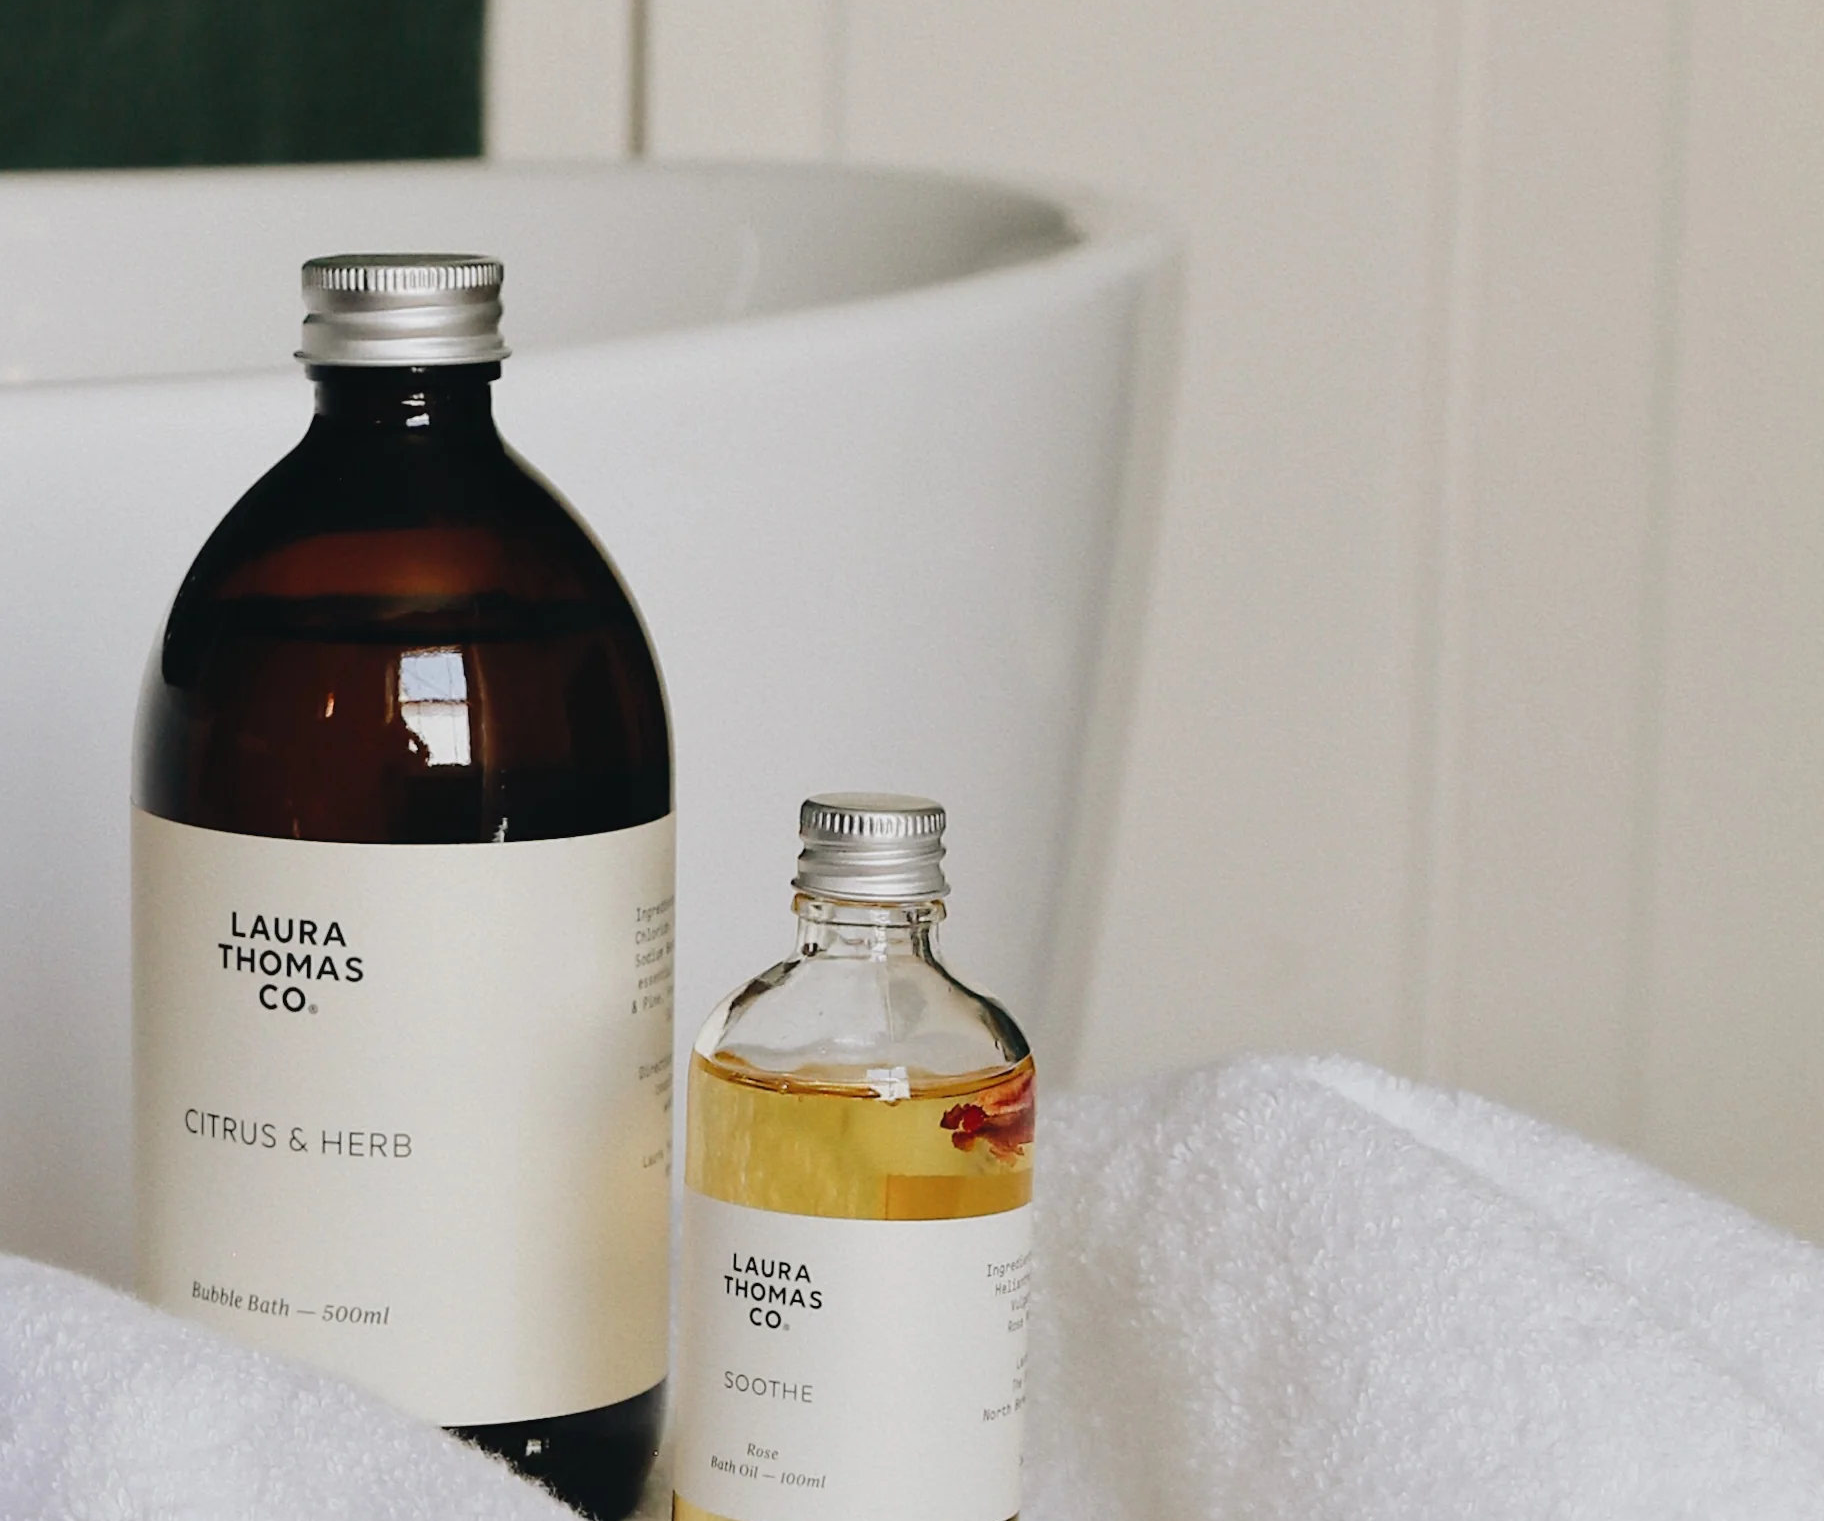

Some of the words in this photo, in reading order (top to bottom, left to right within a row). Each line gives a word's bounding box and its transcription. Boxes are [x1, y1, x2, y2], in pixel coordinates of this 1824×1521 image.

[232, 911, 347, 947] LAURA
[218, 943, 364, 982] THOMAS
[185, 1108, 277, 1149] CITRUS
[289, 1127, 308, 1153] &
[321, 1129, 412, 1158] HERB
[733, 1252, 811, 1283] LAURA
[192, 1280, 243, 1309] Bubble
[247, 1294, 290, 1317] Bath
[322, 1304, 390, 1325] 500ml
[724, 1275, 822, 1309] THOMAS
[724, 1371, 813, 1403] SOOTHE
[746, 1443, 779, 1460] Rose
[711, 1455, 736, 1474] Bath
[739, 1464, 758, 1479] Oil
[780, 1471, 826, 1489] 100ml
